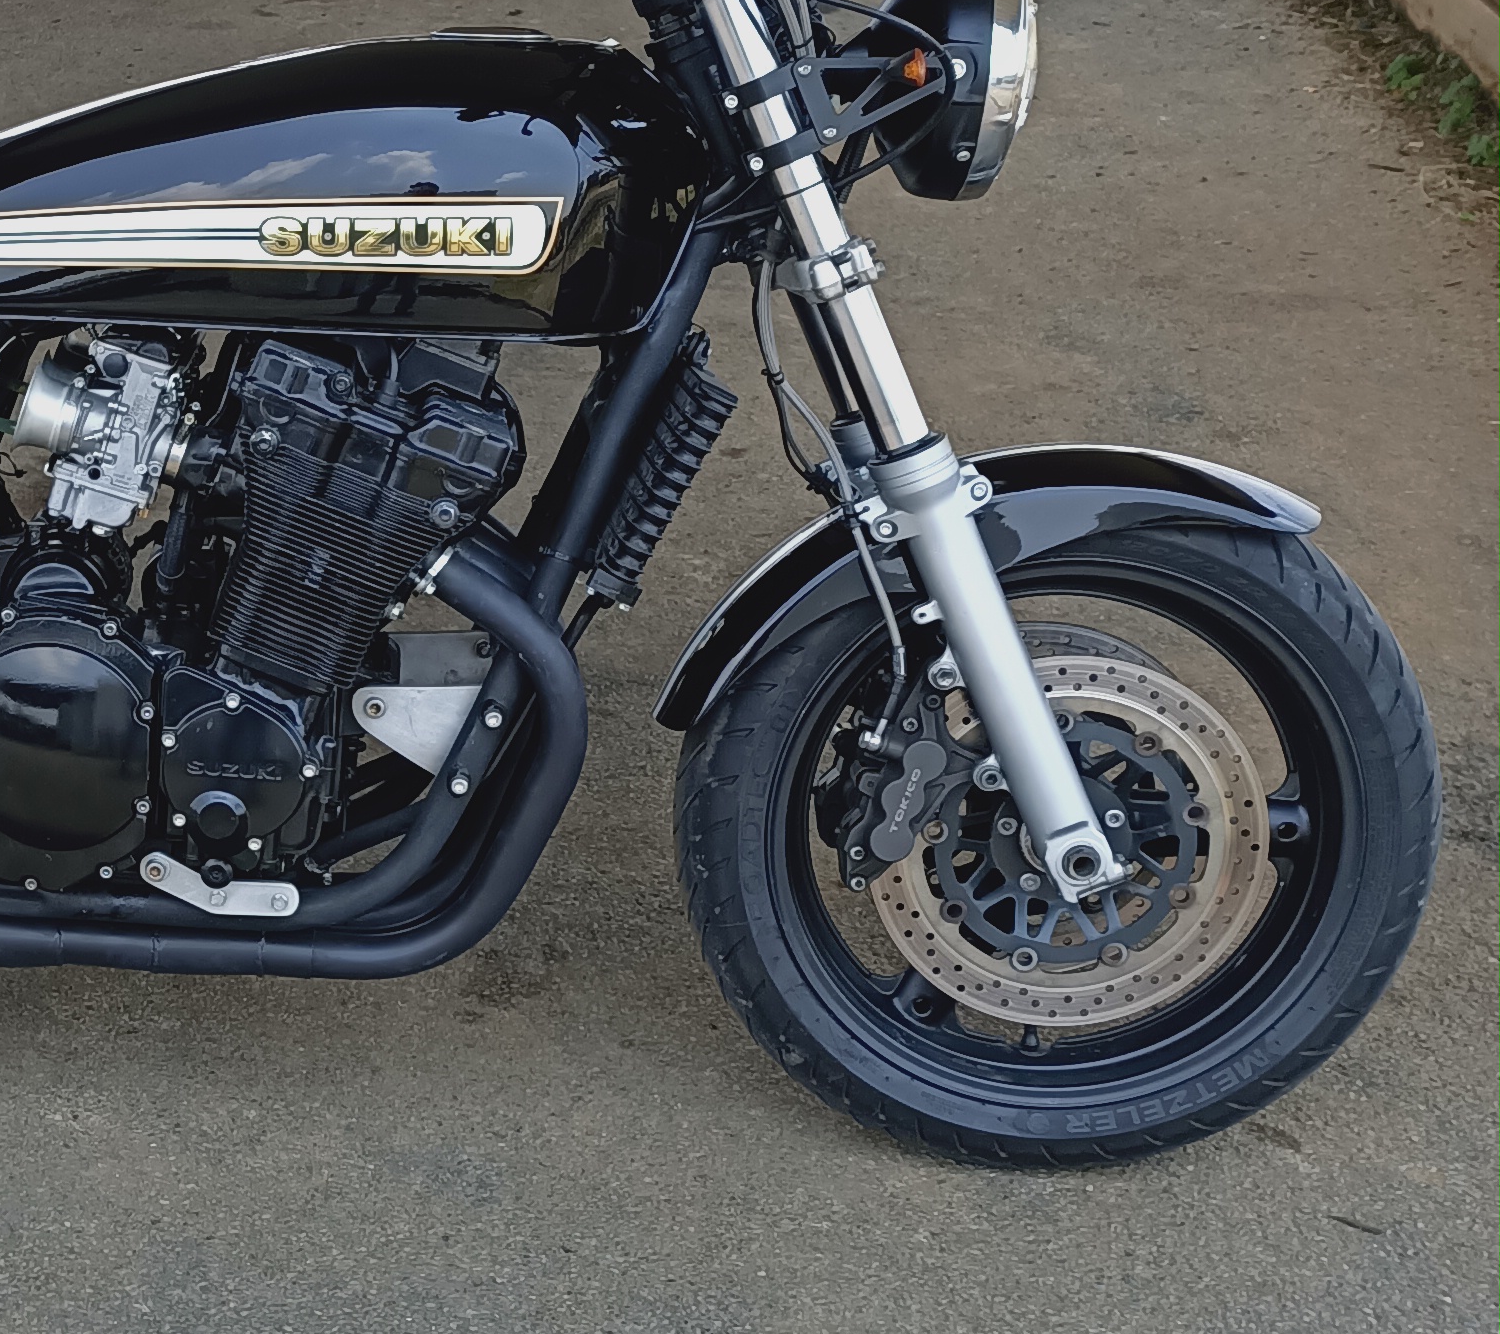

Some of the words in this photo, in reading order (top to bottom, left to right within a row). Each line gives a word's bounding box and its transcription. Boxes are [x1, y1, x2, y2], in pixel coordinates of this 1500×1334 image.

[258, 216, 514, 257] SUZUKI
[186, 760, 282, 781] SUZUKI
[889, 768, 922, 833] TOKICO
[1065, 1047, 1270, 1134] METZELER
